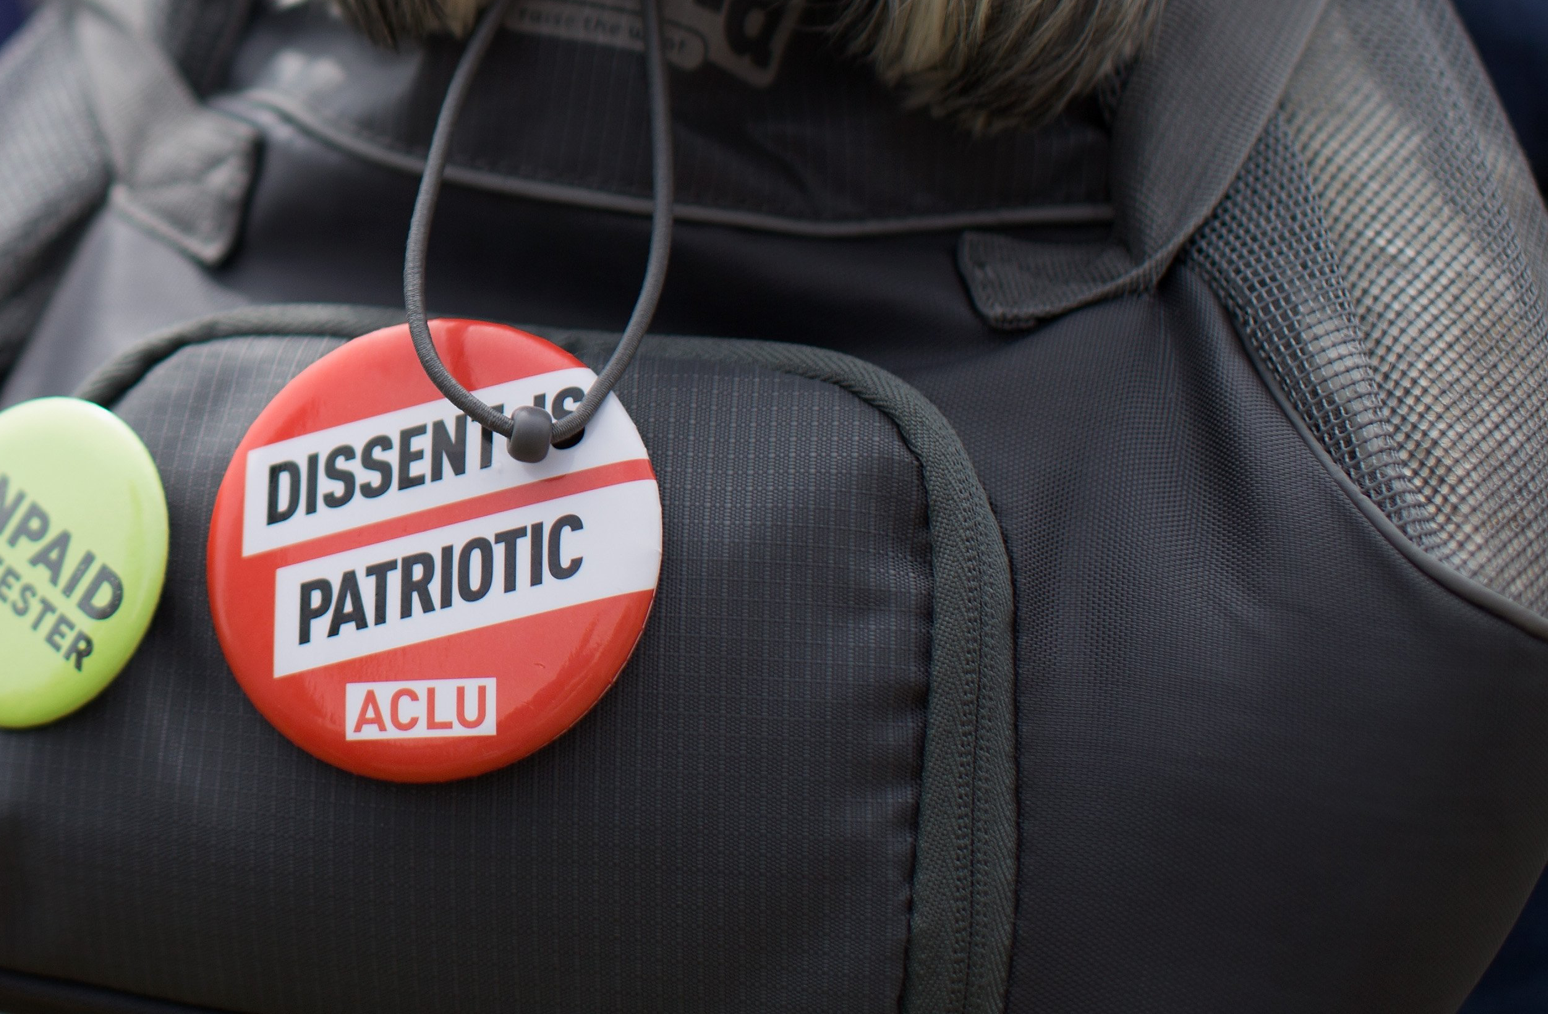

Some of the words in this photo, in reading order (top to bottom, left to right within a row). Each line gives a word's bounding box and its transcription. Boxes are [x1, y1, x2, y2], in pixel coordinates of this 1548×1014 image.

[266, 404, 505, 527] DISSENT
[298, 513, 584, 646] PATRIOTIC
[352, 684, 488, 734] ACLU
